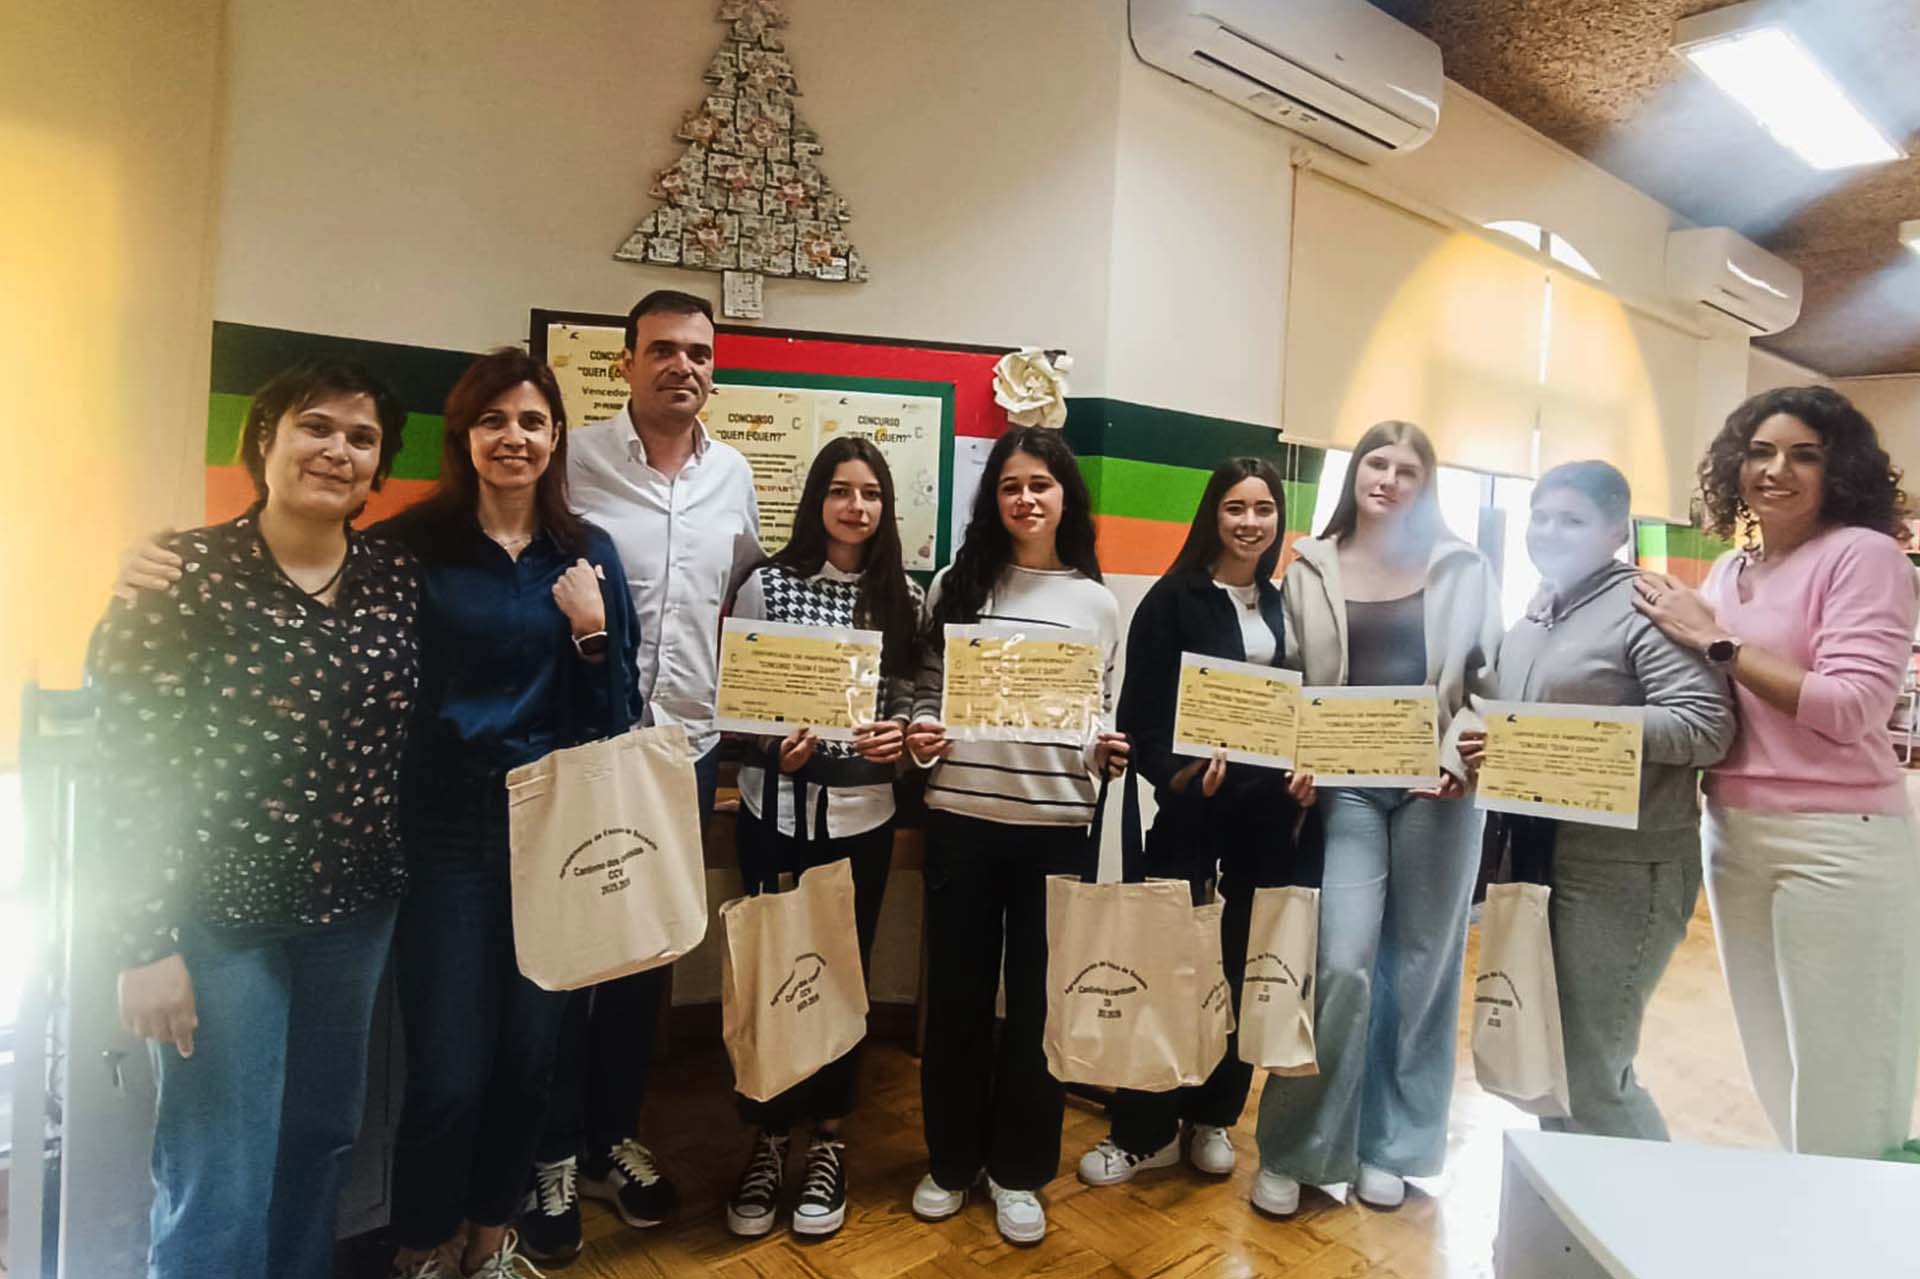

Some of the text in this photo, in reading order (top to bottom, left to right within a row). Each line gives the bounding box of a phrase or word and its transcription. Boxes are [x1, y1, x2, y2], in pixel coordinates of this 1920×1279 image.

[590, 350, 622, 361] CONCU
[728, 412, 774, 425] CONCURSO
[857, 414, 900, 427] CONCURSO
